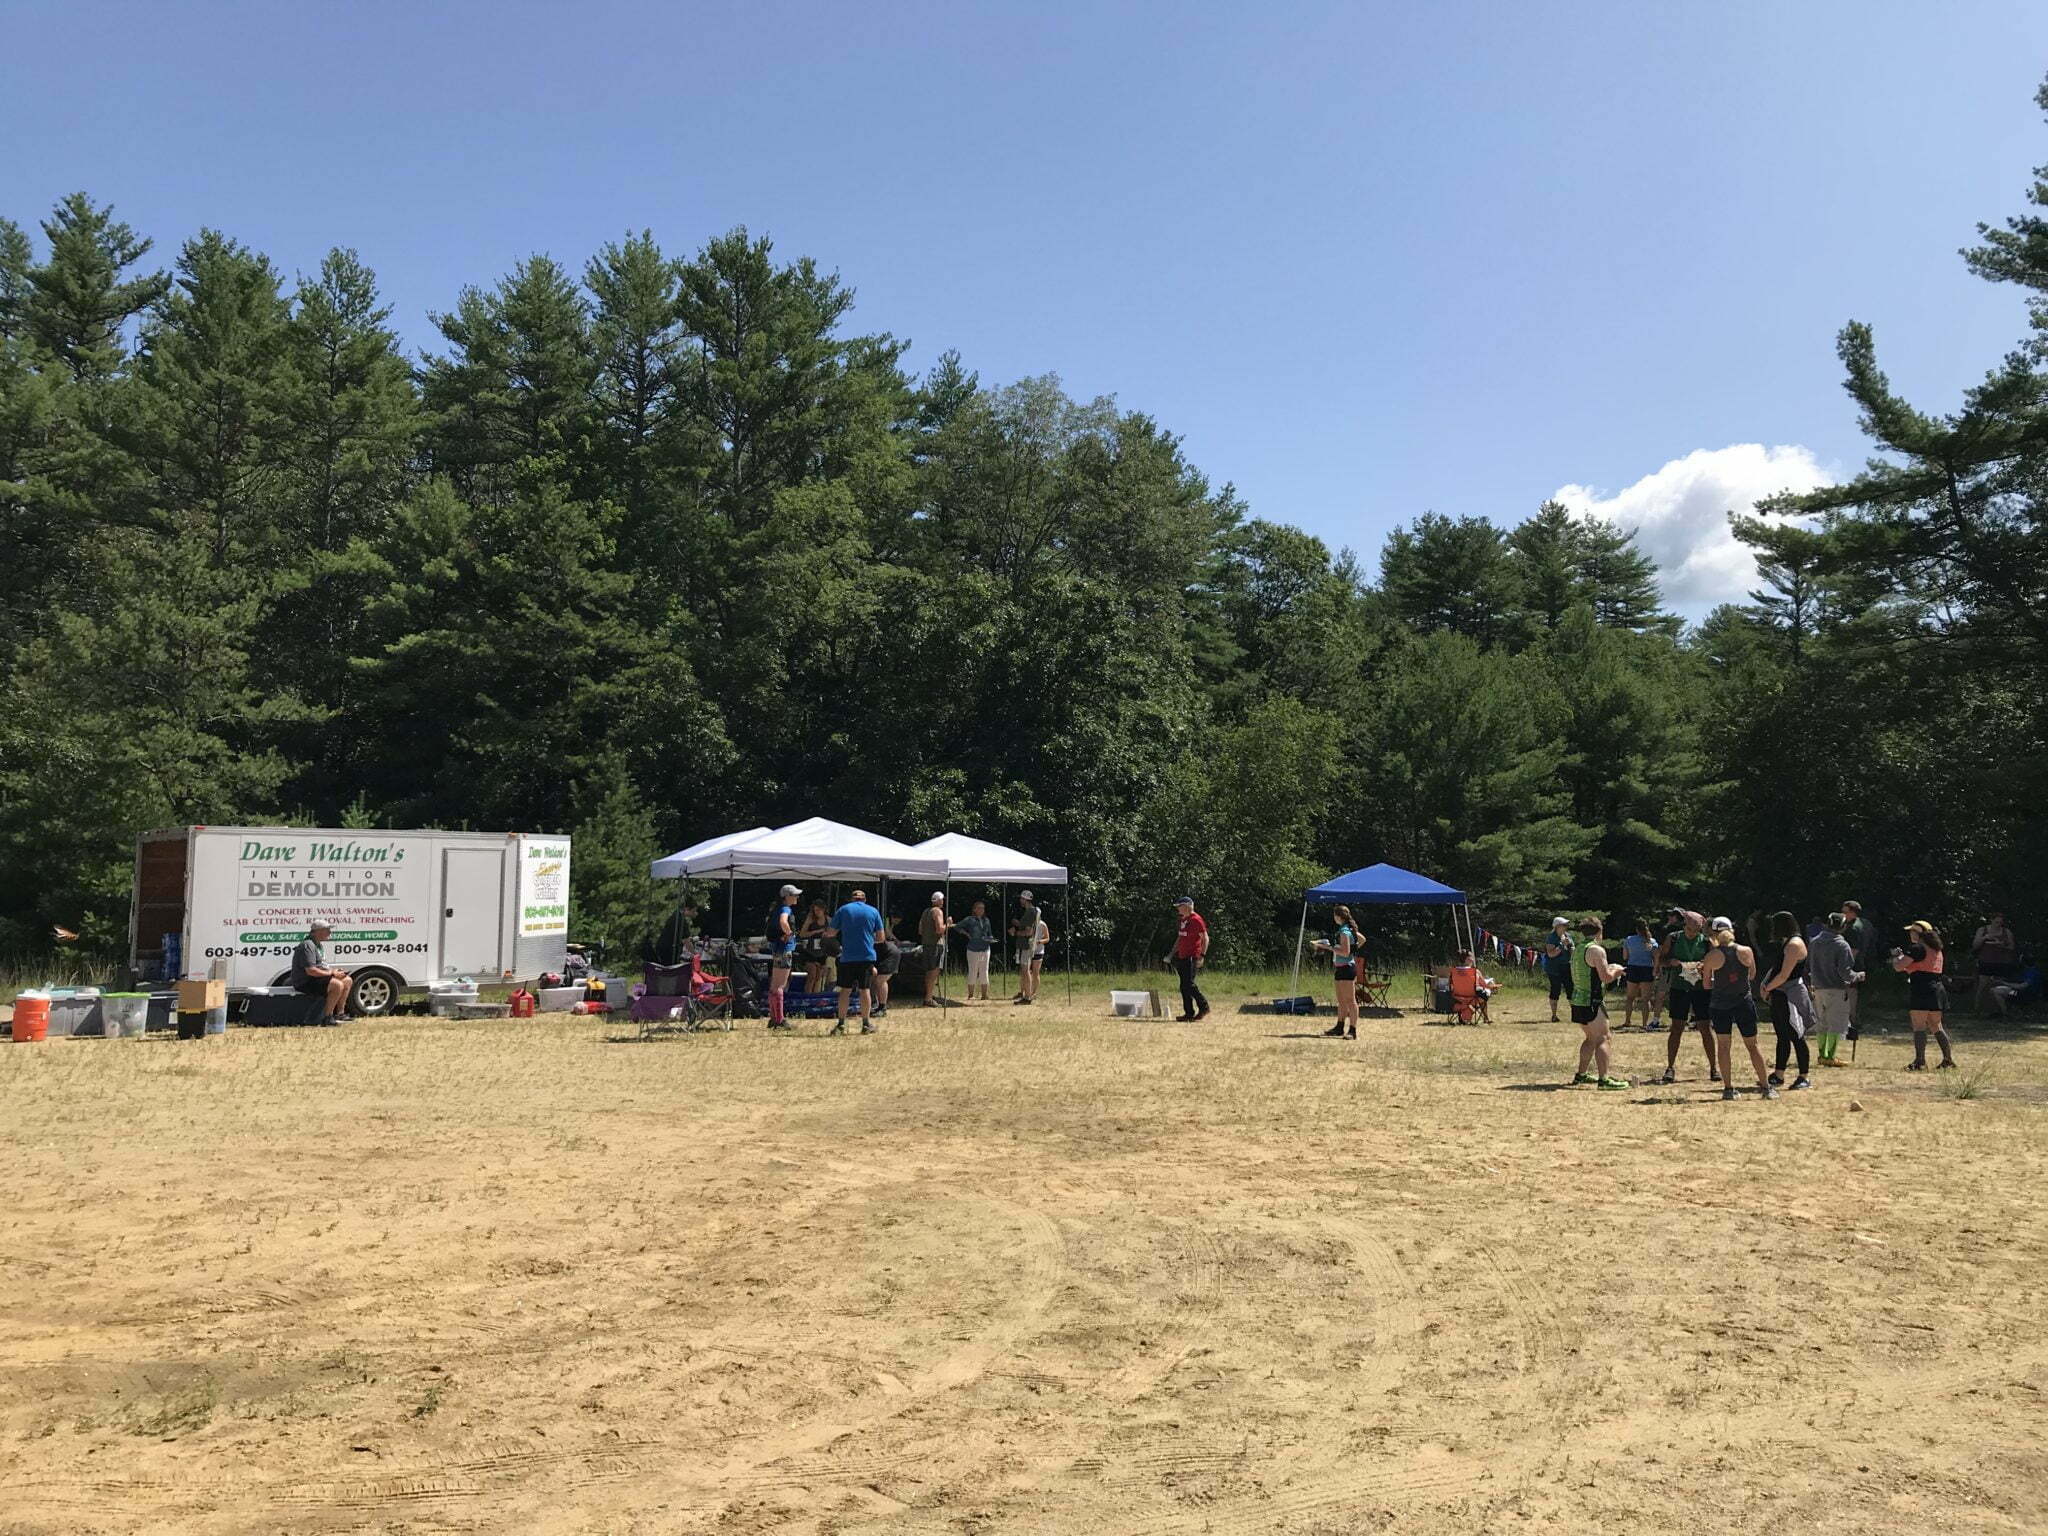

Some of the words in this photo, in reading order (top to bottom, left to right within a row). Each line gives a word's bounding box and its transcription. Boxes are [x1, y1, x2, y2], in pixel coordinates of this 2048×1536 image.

[240, 841, 297, 861] Dave
[309, 840, 406, 863] Walton's
[251, 869, 393, 879] INTERIOR
[247, 881, 396, 897] DEMOLITION
[257, 907, 313, 916] CONCRETE
[317, 906, 342, 915] WALL
[345, 906, 385, 915] SAWING
[223, 918, 249, 926] SLAB
[252, 917, 302, 927] CUTTING,
[360, 915, 416, 925] TRENCHING
[363, 931, 390, 940] WORK
[333, 942, 429, 955] 800-974-8041
